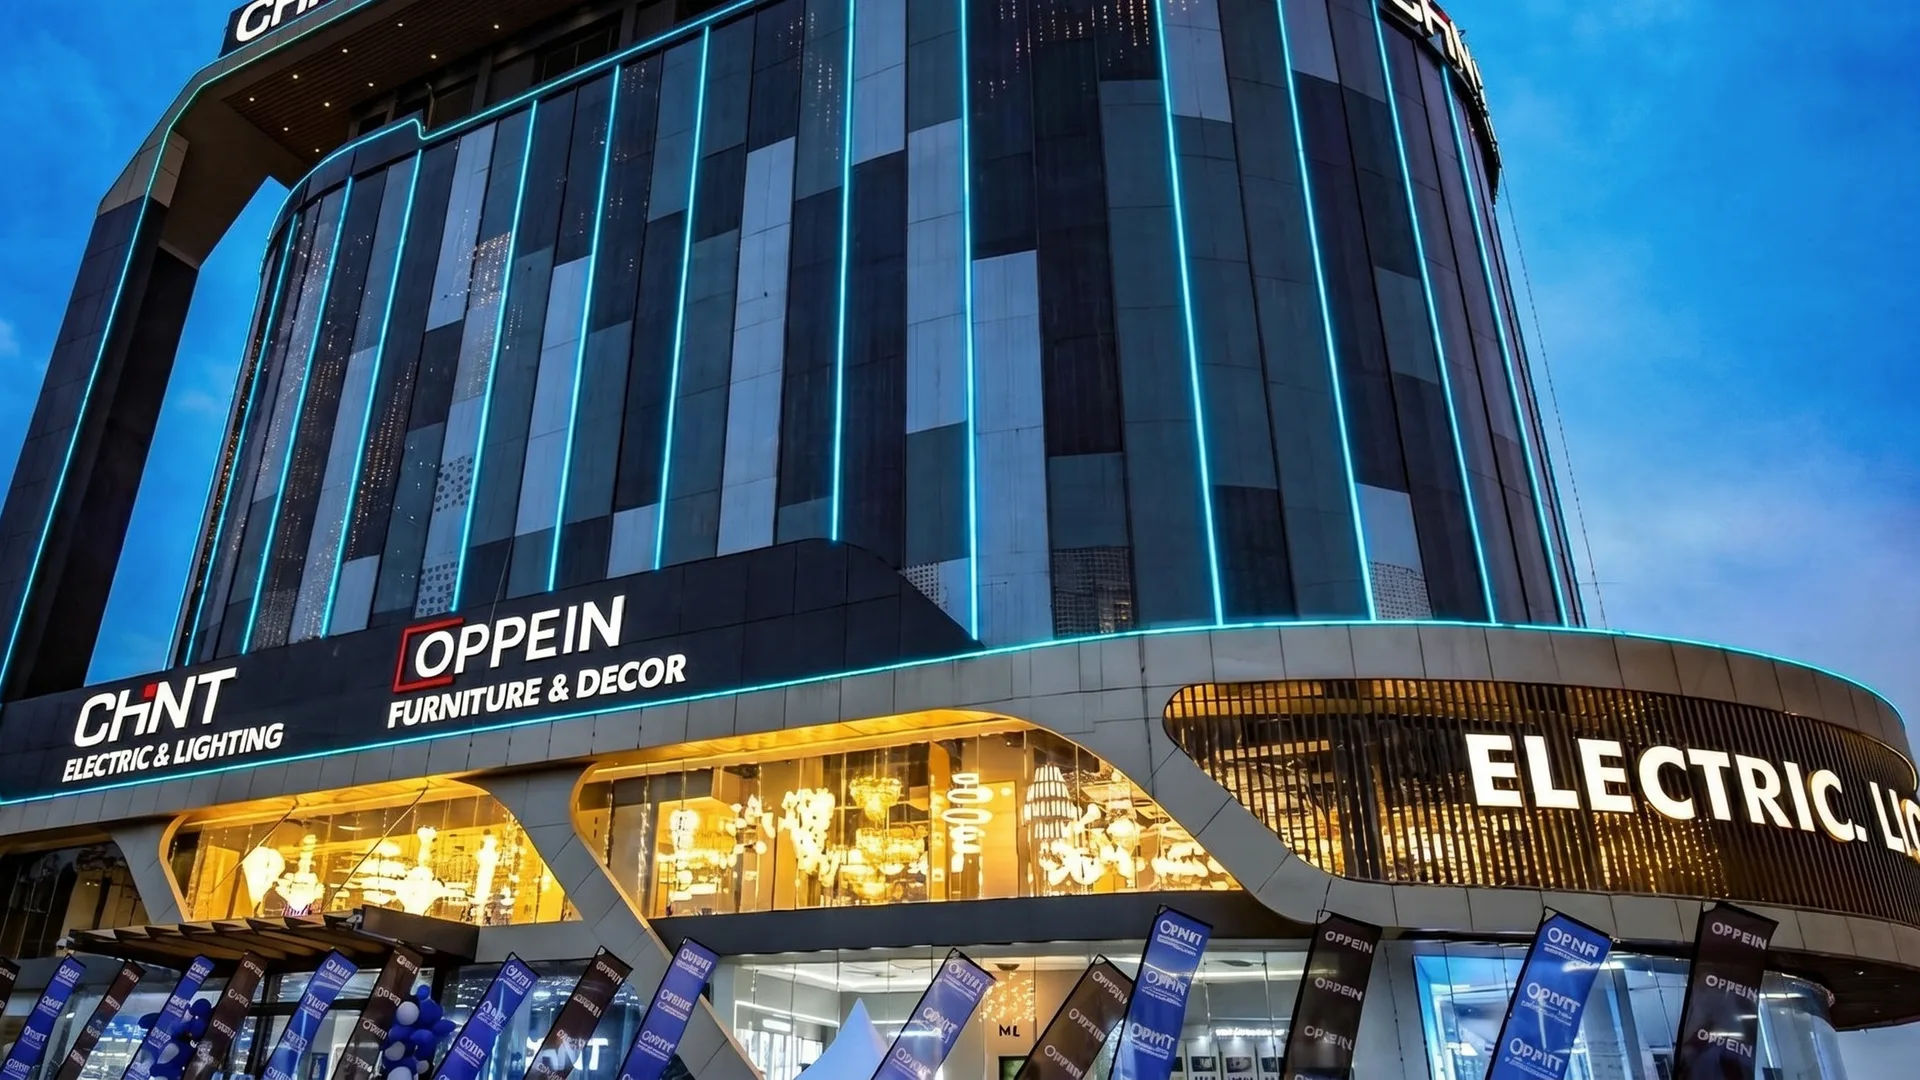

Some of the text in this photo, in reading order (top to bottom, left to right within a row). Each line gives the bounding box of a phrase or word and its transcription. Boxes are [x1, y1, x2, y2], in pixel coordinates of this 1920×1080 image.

[415, 595, 625, 678] OPPEIN
[387, 653, 686, 729] FURNITURE & DECOR
[62, 723, 285, 783] ELECTRIC & LIGHTING
[1465, 733, 1868, 843] ELECTRIC.
[1325, 931, 1373, 954] OPPEIN
[1712, 922, 1767, 950] OPPEIN
[999, 1024, 1020, 1037] ML
